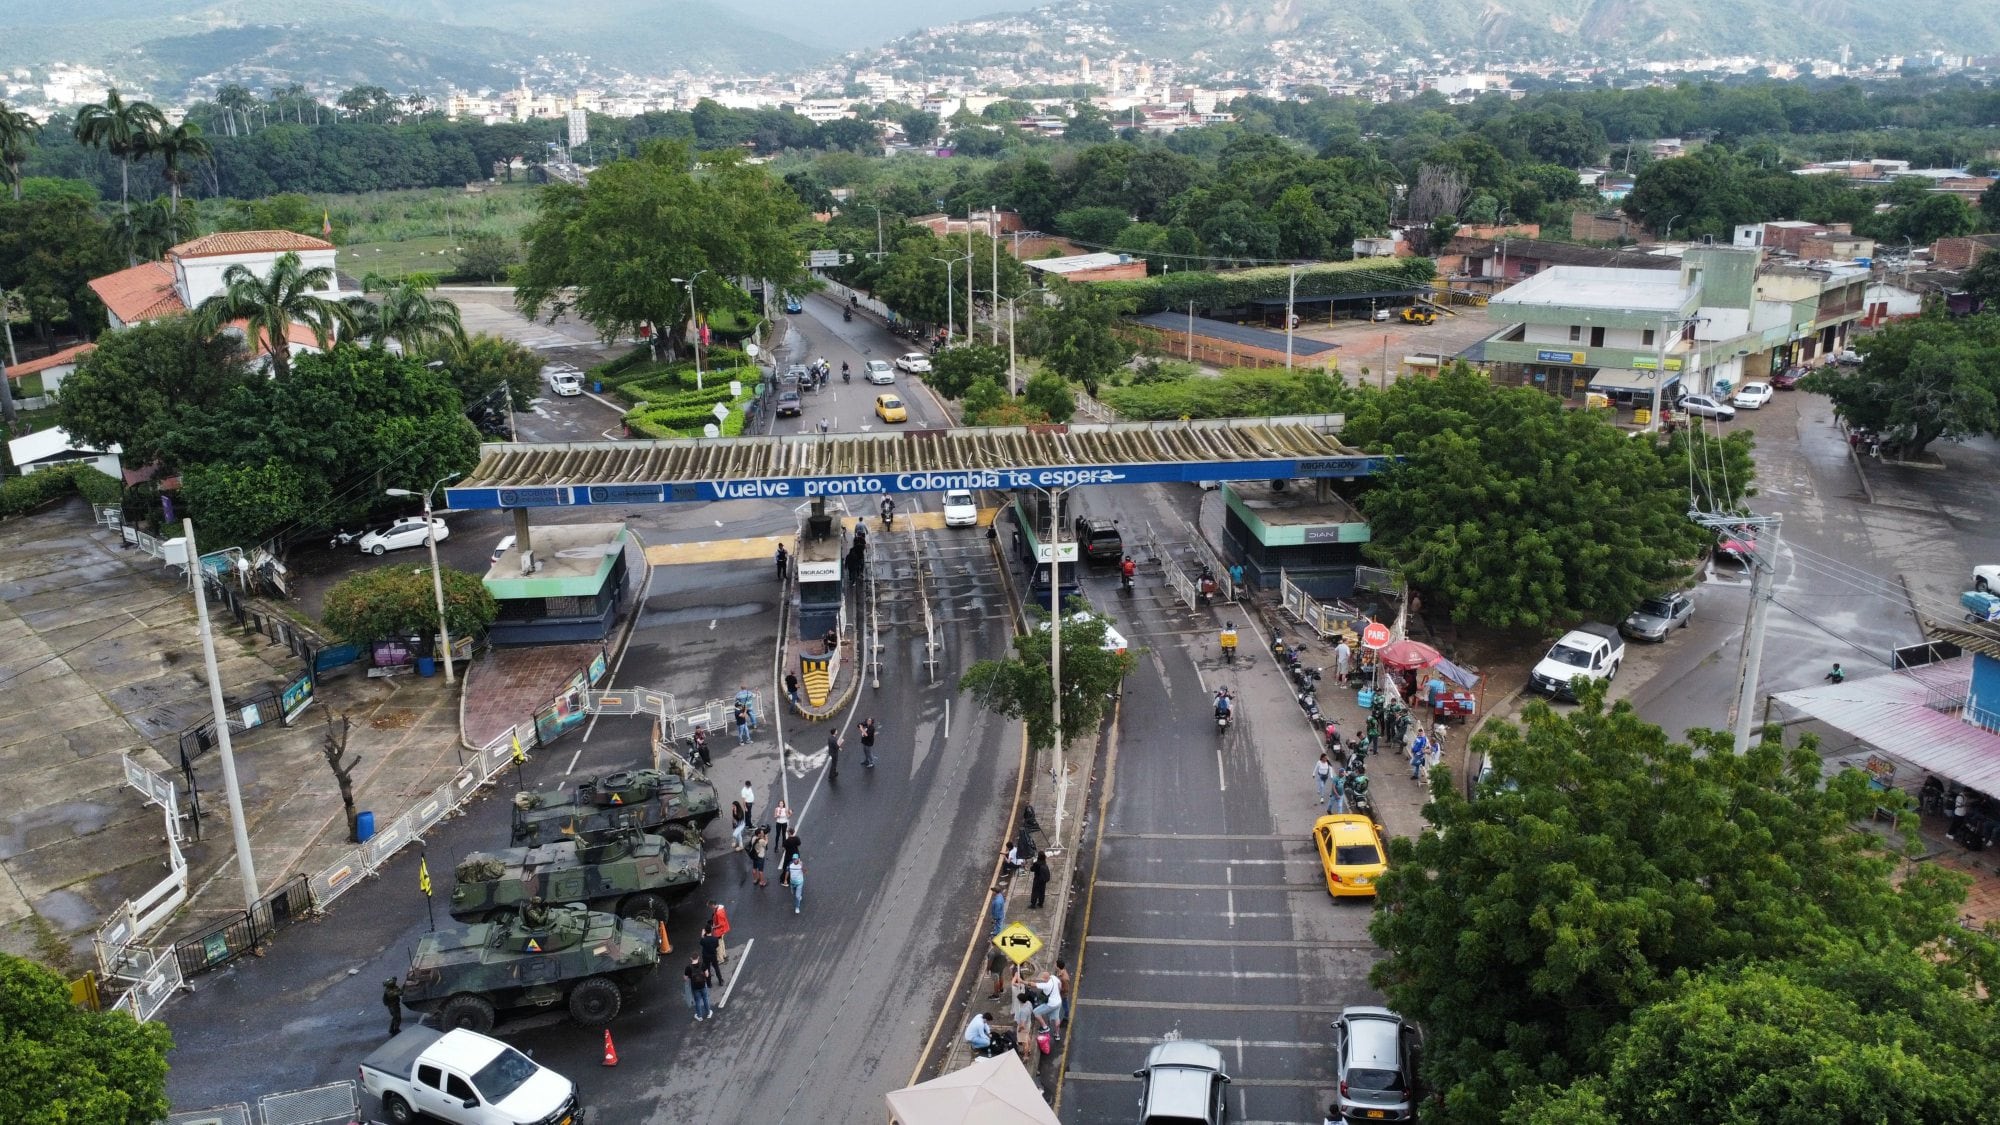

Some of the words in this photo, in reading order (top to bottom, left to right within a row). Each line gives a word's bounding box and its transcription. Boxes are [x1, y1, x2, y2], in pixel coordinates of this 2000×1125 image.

[712, 481, 789, 498] Vuelve
[896, 473, 1000, 490] Colombia
[1009, 470, 1031, 486] te
[1039, 469, 1113, 486] espera
[1367, 629, 1386, 640] PARE
